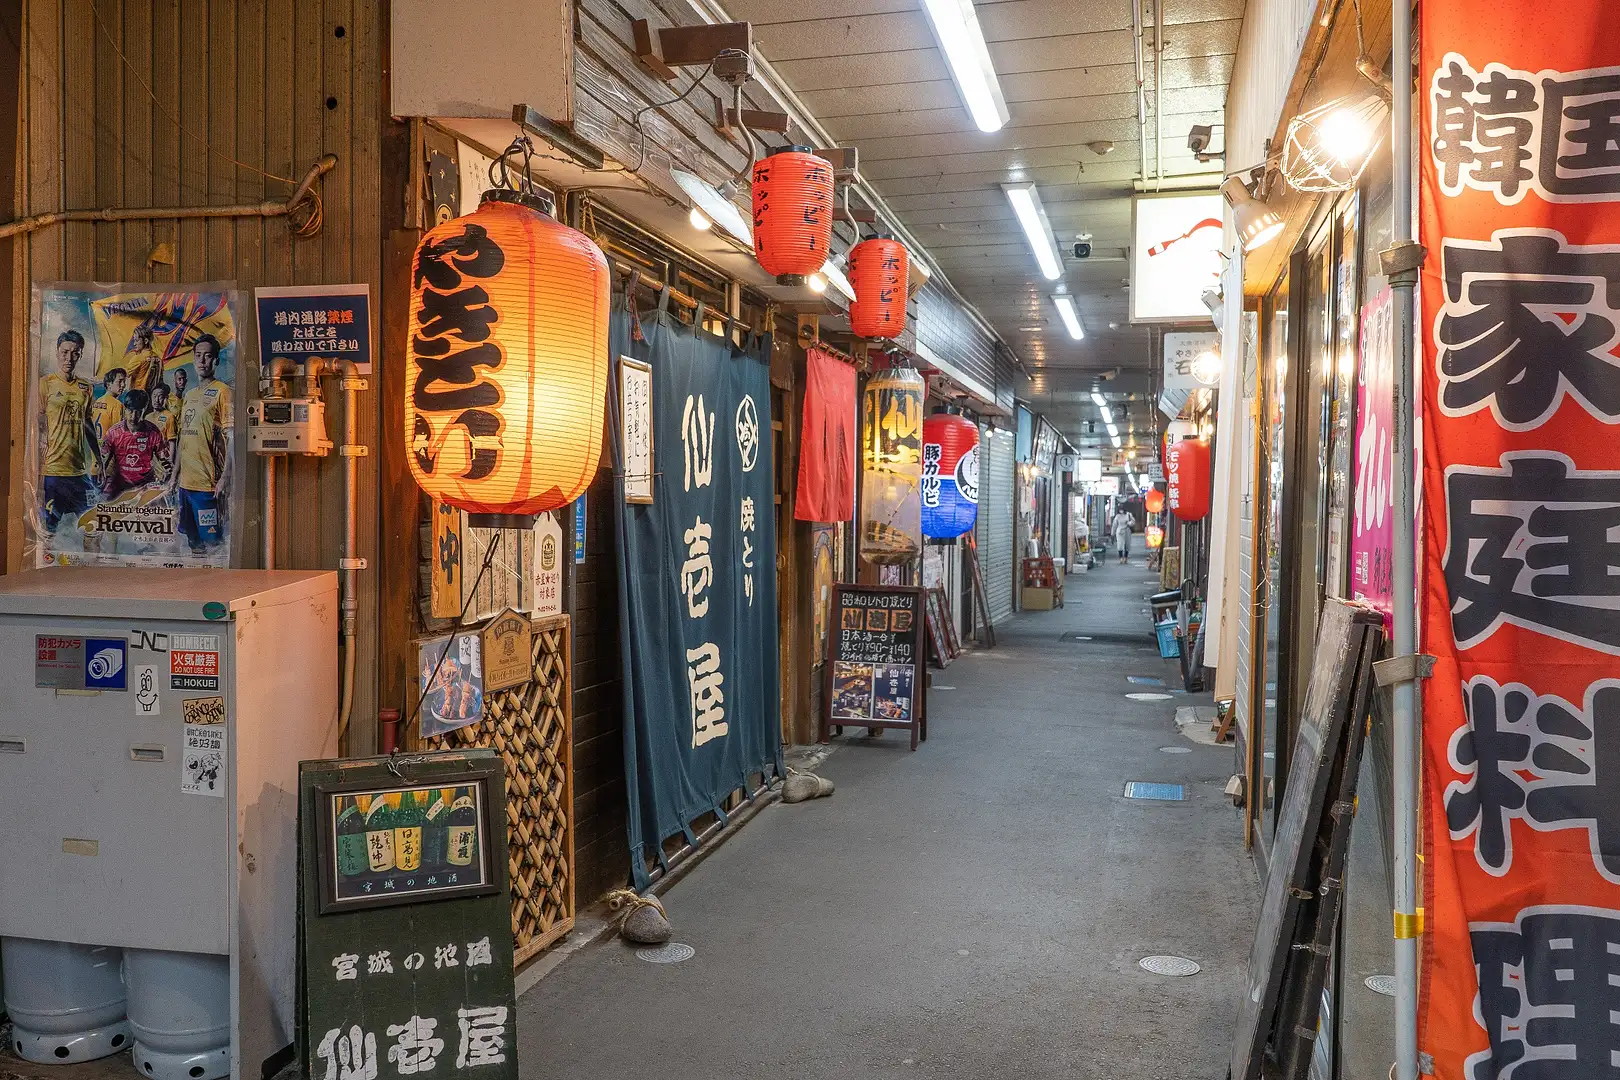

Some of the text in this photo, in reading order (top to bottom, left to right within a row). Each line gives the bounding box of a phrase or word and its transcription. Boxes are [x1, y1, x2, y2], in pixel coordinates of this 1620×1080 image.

[1432, 52, 1620, 205] 韓国
[803, 167, 826, 251] ホッピー
[880, 255, 900, 322] ホッピー
[274, 309, 354, 326] 場内通路禁煙
[292, 326, 338, 339] たばこを
[271, 339, 359, 353] 吸わないで下さい
[411, 223, 506, 480] やきとり
[924, 445, 941, 506] 豚カルビ
[135, 506, 175, 517] together
[96, 514, 174, 535] Revival
[38, 637, 82, 650] 防犯カメラ
[173, 653, 216, 667] 火気厳禁
[1435, 228, 1620, 1080] 家庭料理
[204, 667, 215, 675] FIRE
[183, 678, 217, 688] HOKUEI
[362, 873, 457, 893] 宮城の地酒
[331, 936, 492, 981] 宮城の地酒
[316, 1004, 508, 1080] 仙壱屋
